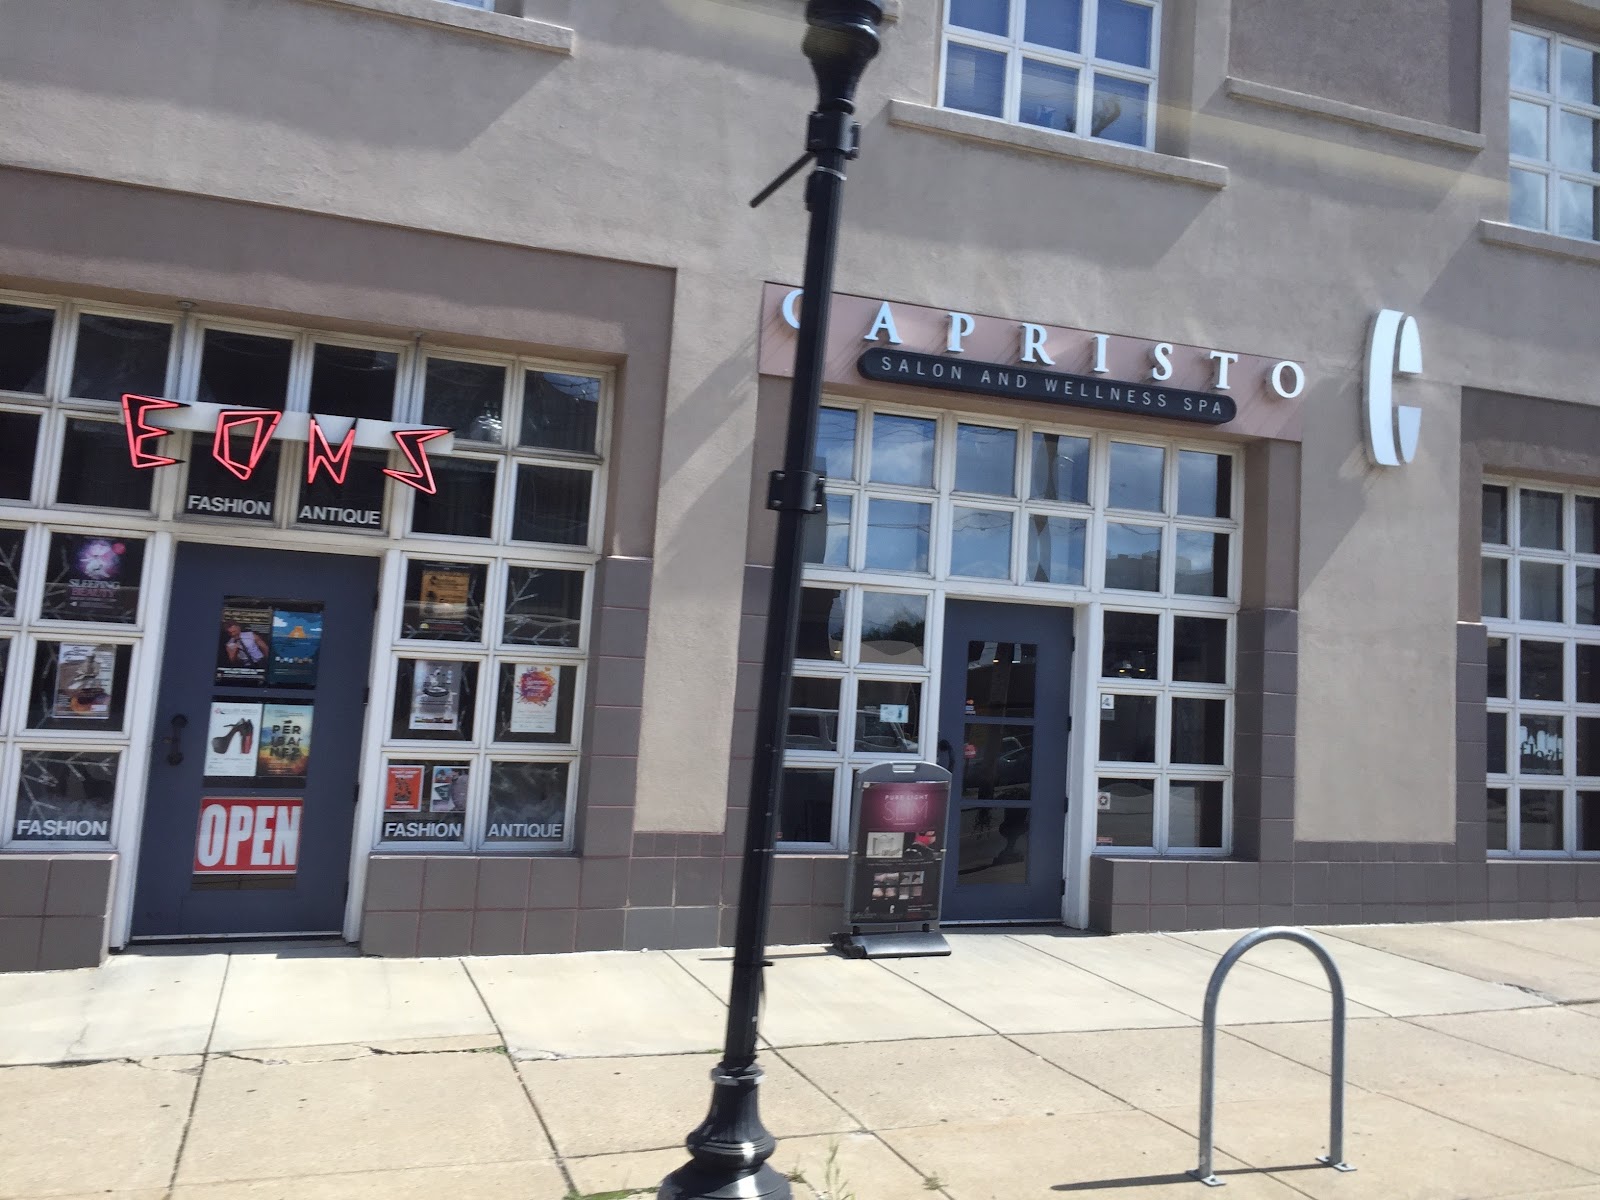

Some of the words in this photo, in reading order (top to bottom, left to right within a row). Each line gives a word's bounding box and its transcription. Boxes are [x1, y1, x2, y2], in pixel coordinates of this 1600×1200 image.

[780, 288, 1306, 400] CAPRISTO
[881, 356, 962, 380] SALON
[980, 371, 1028, 389] AND
[1044, 378, 1168, 408] WELLNESS
[1183, 397, 1223, 415] SPA
[120, 393, 455, 495] EONS
[187, 494, 272, 516] FASHION
[299, 505, 381, 525] ANTIQUE
[16, 819, 108, 836] FASHION
[197, 803, 302, 867] OPEN
[384, 822, 462, 838] FASHION
[487, 823, 563, 838] ANTIQUE
